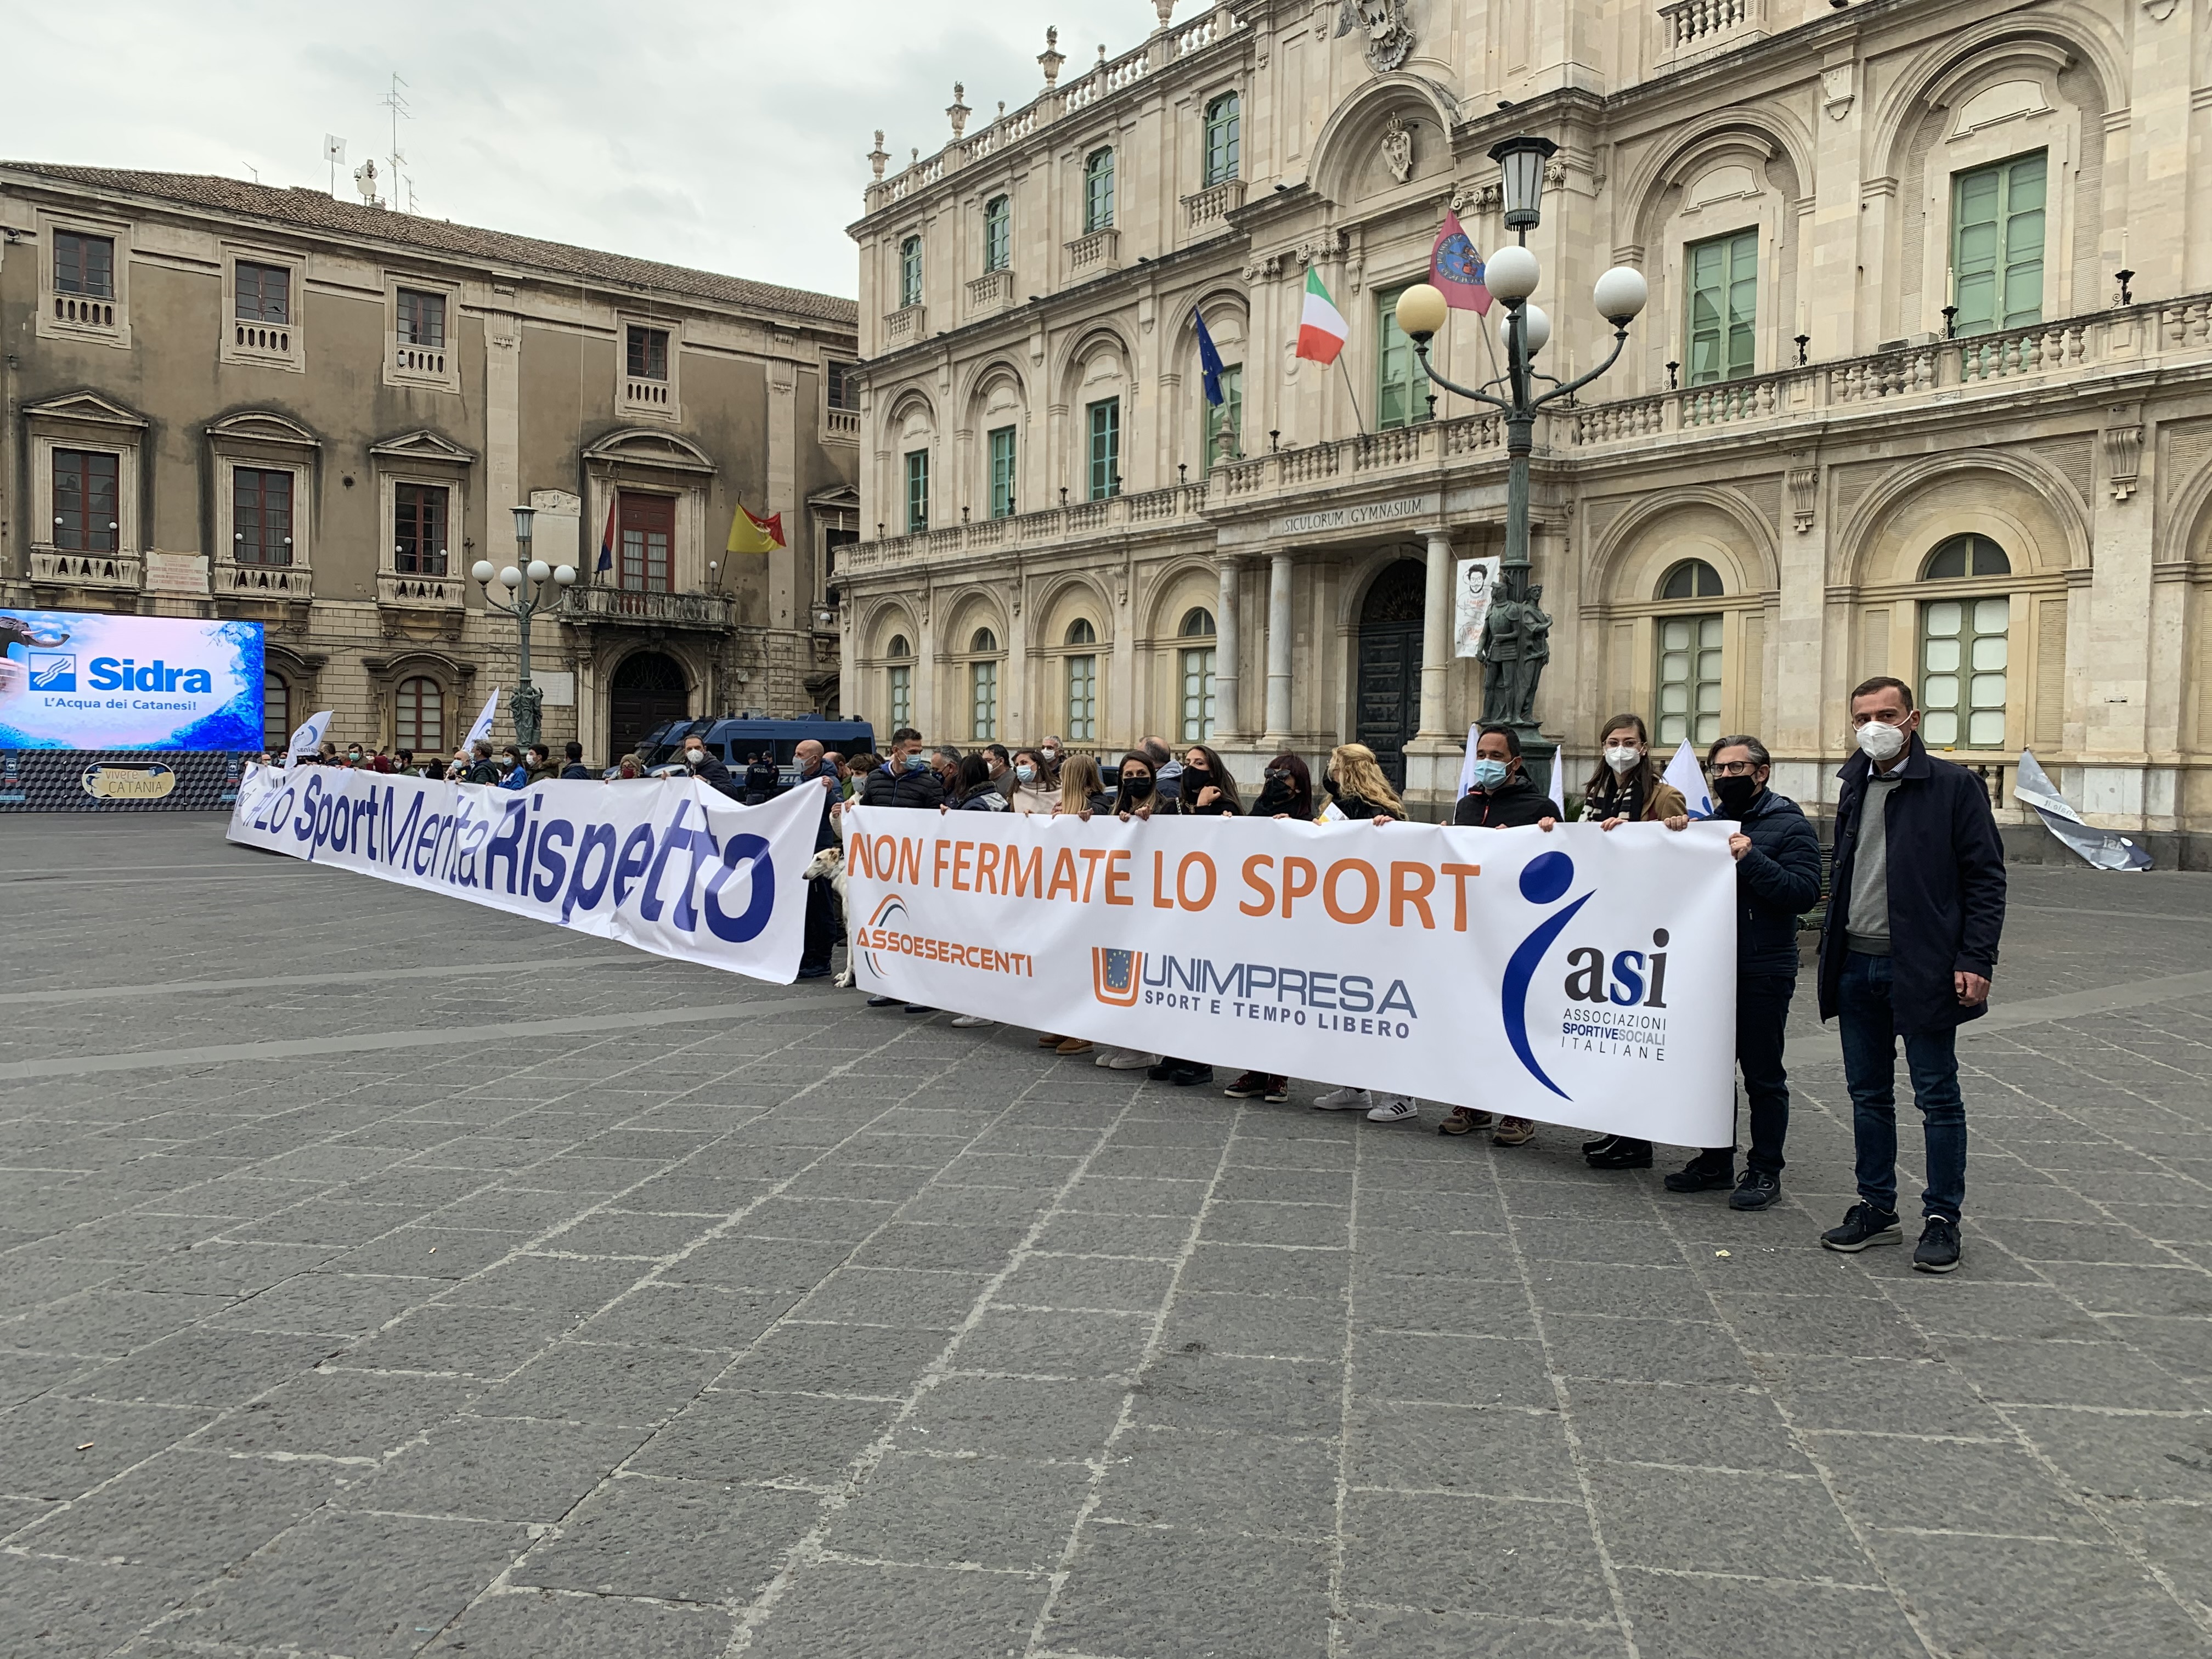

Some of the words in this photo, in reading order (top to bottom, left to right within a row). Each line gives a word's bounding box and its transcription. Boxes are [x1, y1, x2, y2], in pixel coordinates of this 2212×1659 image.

[1284, 511, 1344, 532] SICULORUM
[1351, 498, 1422, 522] GYMNASIUM
[87, 657, 212, 693] Sidra
[44, 697, 101, 710] L'Acqua
[105, 698, 127, 709] dei
[132, 699, 196, 711] Catanesi!
[105, 770, 138, 780] vivere
[109, 781, 163, 794] CATANIA
[848, 832, 923, 885] NON
[933, 839, 1133, 906] FERMATE
[1153, 850, 1217, 912] LO
[1239, 854, 1481, 932] SPORT
[856, 927, 1032, 977] ASSOESERCENTI
[1564, 927, 1670, 1009] asi
[1143, 952, 1419, 1019] UNIMPRESA
[1145, 990, 1201, 1011] SPORT
[1210, 999, 1221, 1014] E
[1233, 1002, 1306, 1026] TEMPO
[1318, 1013, 1410, 1039] LIBERO
[1563, 1008, 1666, 1031] ASSOCIAZIONI
[1561, 1036, 1664, 1061] ITALIANE
